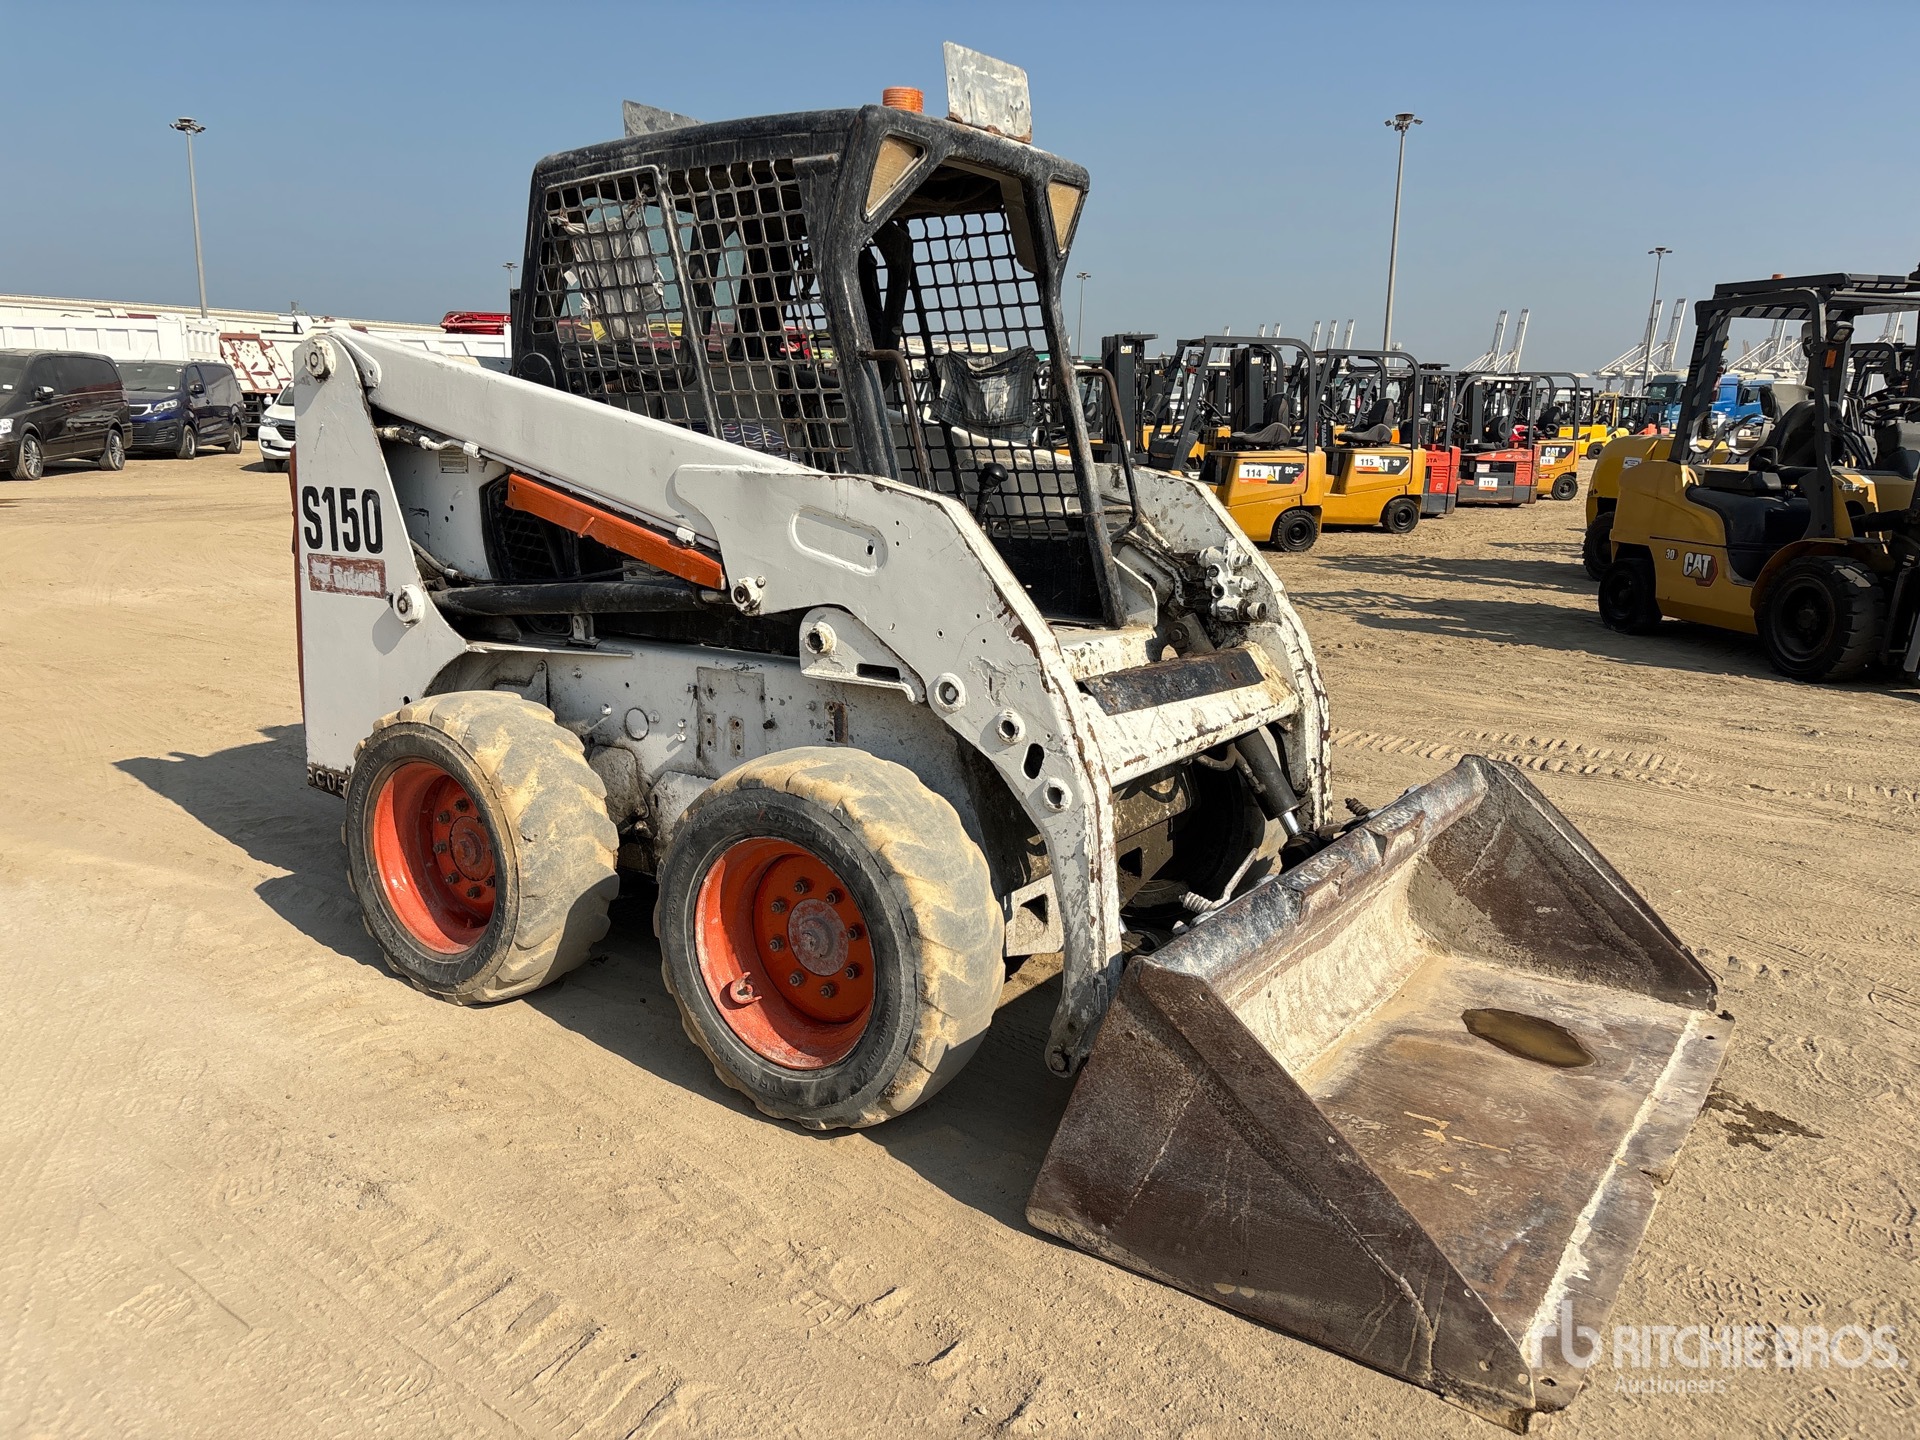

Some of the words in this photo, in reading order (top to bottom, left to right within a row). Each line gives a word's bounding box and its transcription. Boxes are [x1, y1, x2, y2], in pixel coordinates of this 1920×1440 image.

[1120, 345, 1133, 354] CAT
[1251, 356, 1262, 365] CAT
[1545, 447, 1560, 457] CAT
[1361, 458, 1374, 466] 115
[1379, 459, 1391, 472] AT
[1246, 468, 1262, 477] 114
[1267, 465, 1283, 481] AT
[302, 485, 384, 555] S150
[1665, 548, 1675, 560] 30
[1683, 552, 1712, 579] CAT
